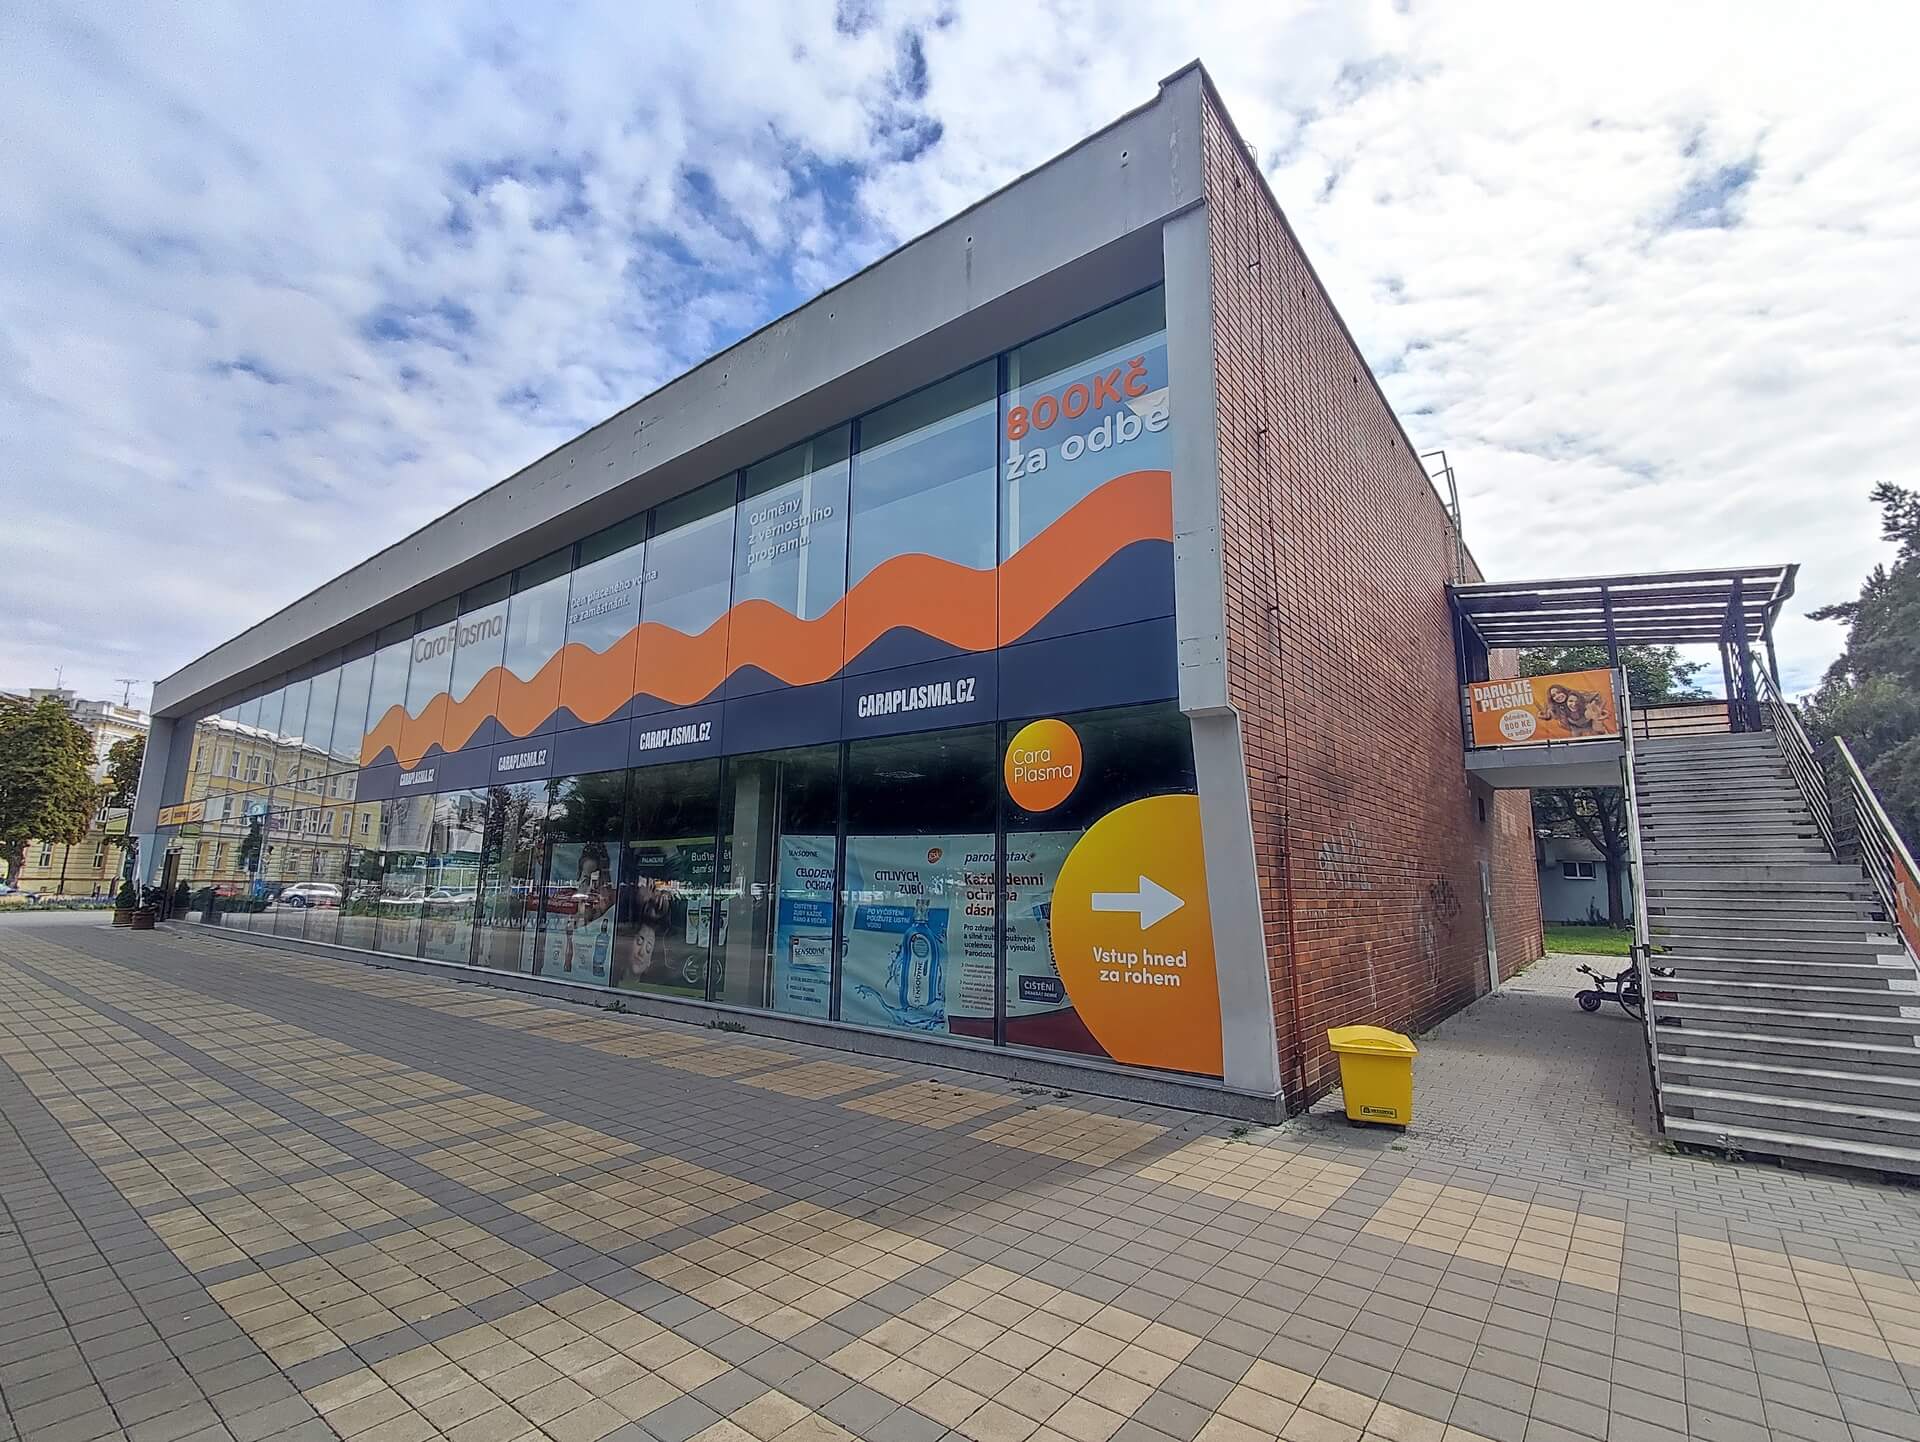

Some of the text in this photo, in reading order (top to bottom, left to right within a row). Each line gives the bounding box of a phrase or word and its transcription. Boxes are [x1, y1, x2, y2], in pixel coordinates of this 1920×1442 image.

[1007, 355, 1148, 440] 800Kč
[1006, 447, 1047, 481] za
[750, 499, 801, 526] Odměny
[747, 534, 756, 546] z
[747, 536, 811, 567] programu.
[632, 569, 658, 586] vona
[414, 615, 503, 663] CaraPlasma
[857, 677, 976, 718] CARAPLASMA.CZ
[1473, 680, 1532, 702] DARUJTE
[1481, 692, 1534, 712] PLASMU
[639, 721, 712, 750] CARAPLASMA.CZ
[497, 749, 548, 772] CARAPLASMA.CZ
[1013, 749, 1051, 765] Cara
[399, 768, 435, 786] CARAPLASMA.CZ
[1014, 764, 1073, 784] Plasma
[874, 869, 920, 881] CITLIVÝCH
[964, 872, 1044, 886] Každdenní
[966, 887, 1017, 902] ochrna
[1005, 934, 1036, 945] oužívejte
[1093, 946, 1187, 969] Vstup hned
[1099, 967, 1180, 986] za rohem
